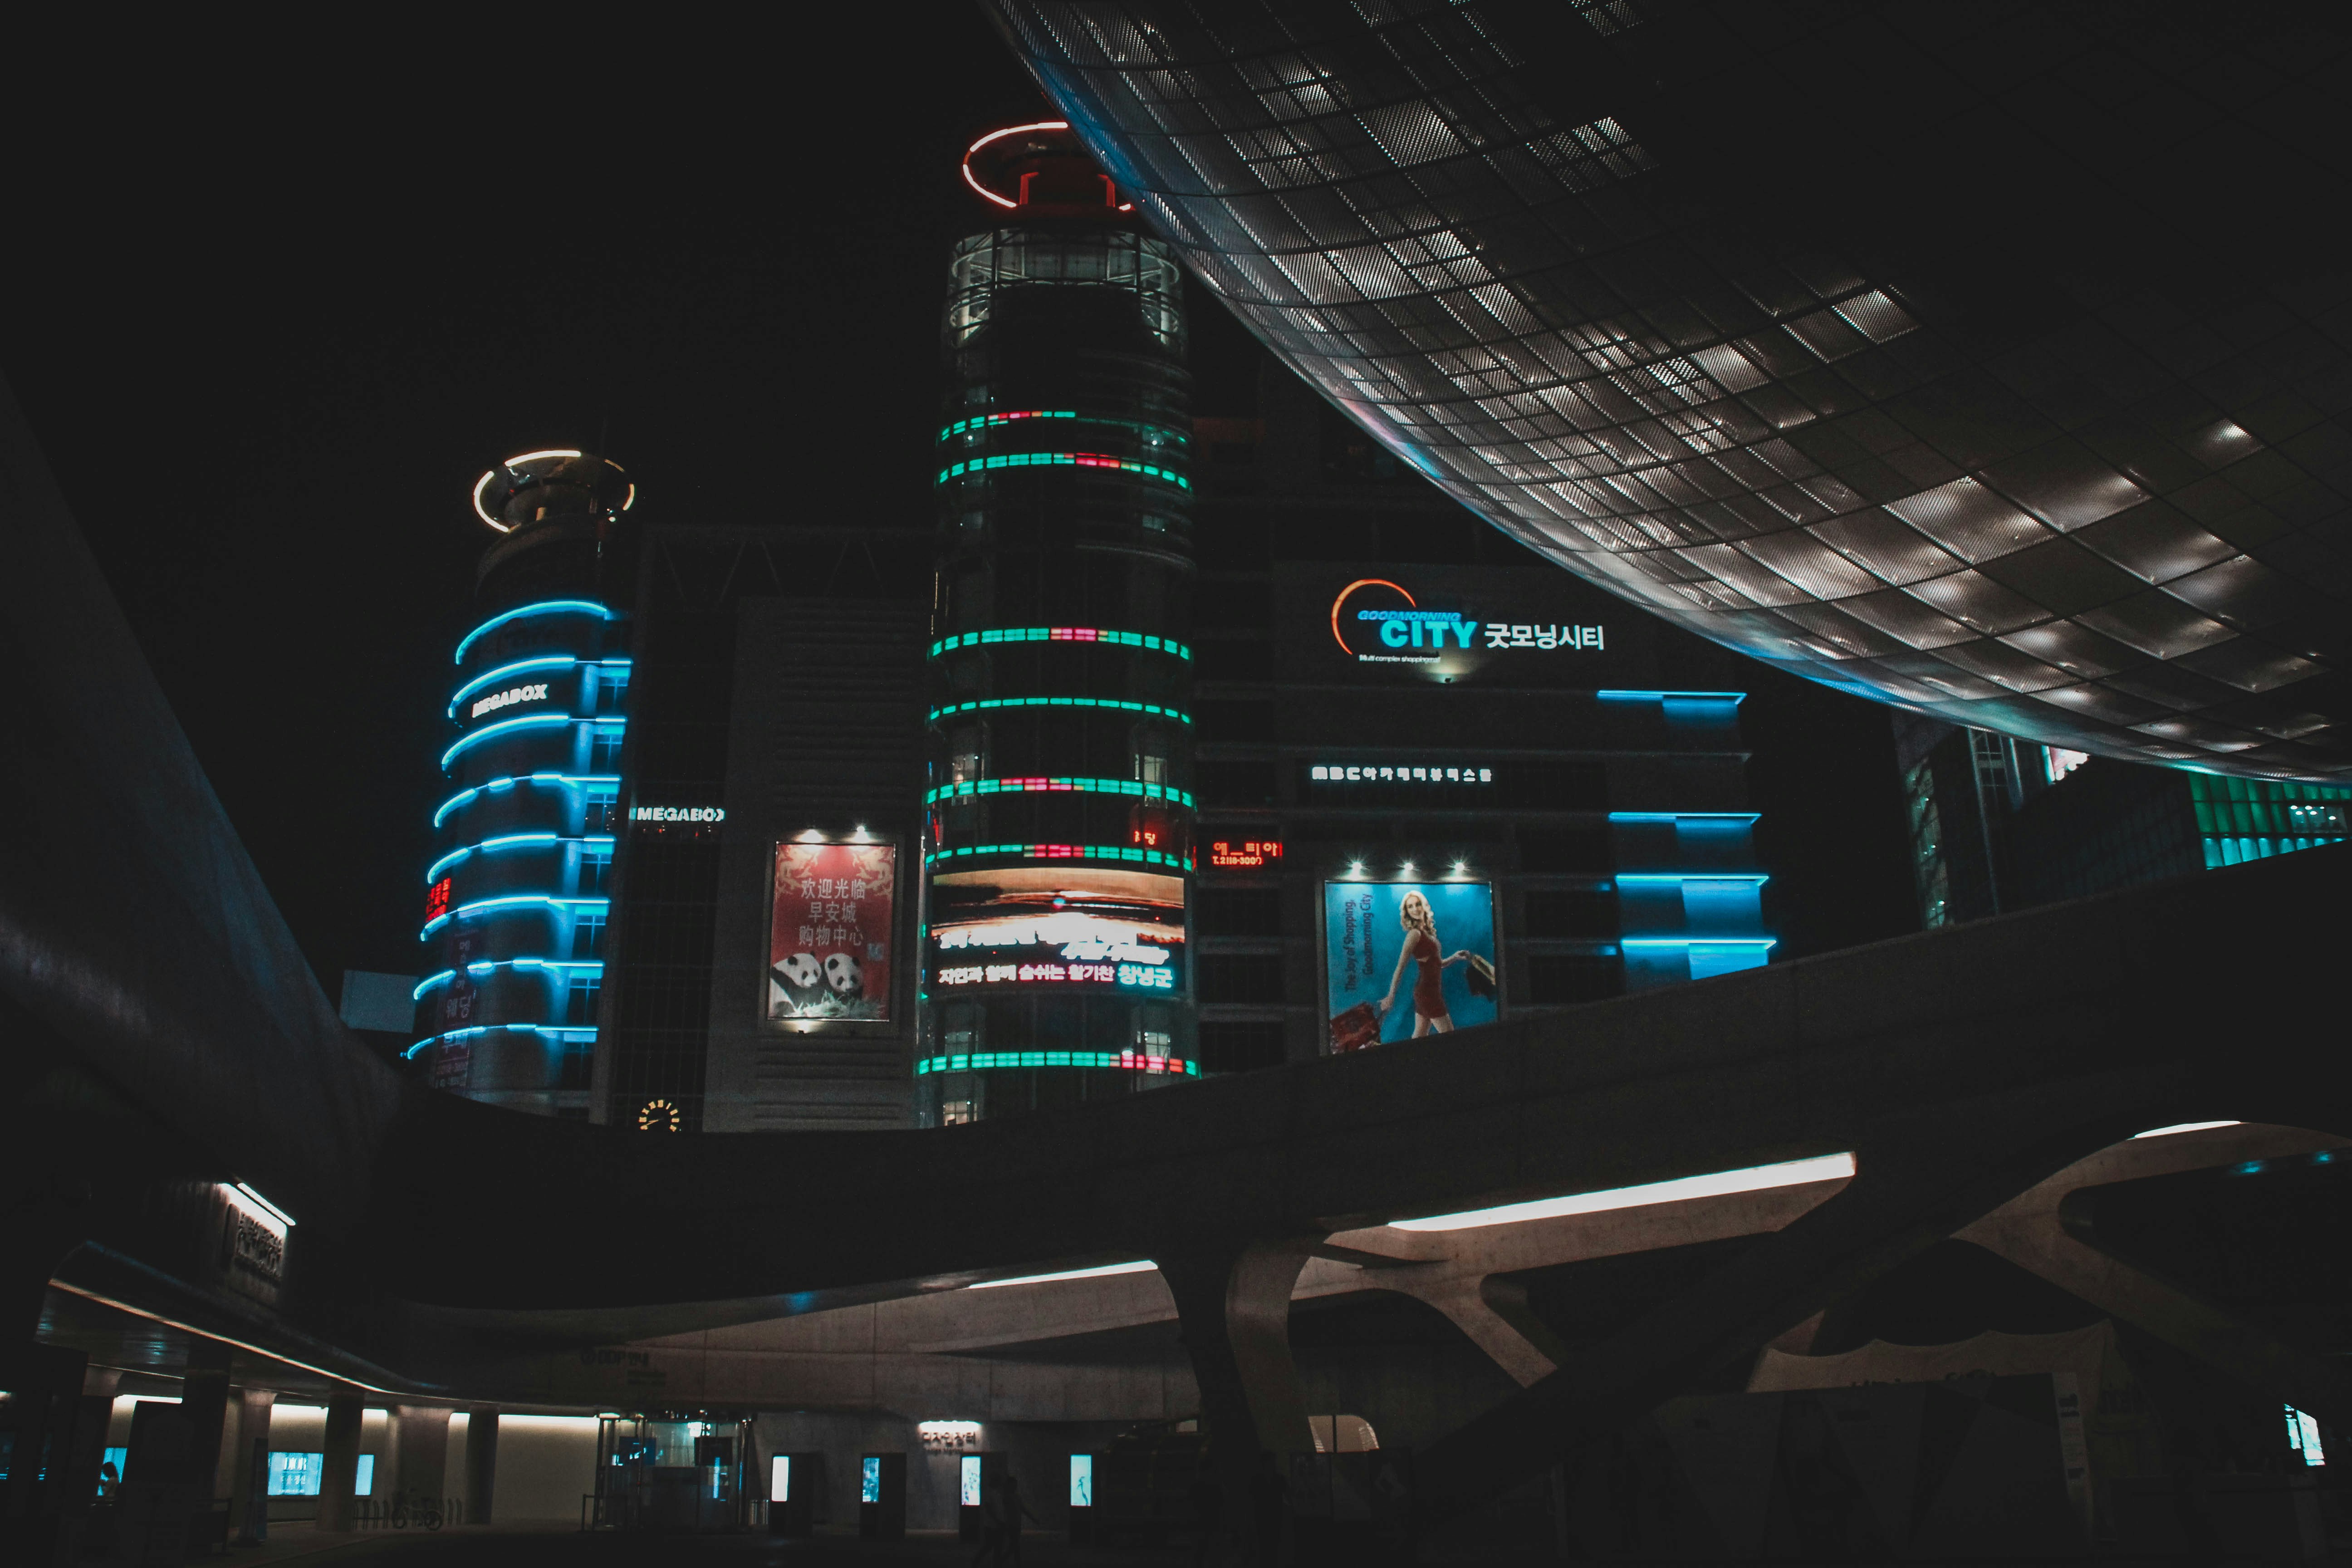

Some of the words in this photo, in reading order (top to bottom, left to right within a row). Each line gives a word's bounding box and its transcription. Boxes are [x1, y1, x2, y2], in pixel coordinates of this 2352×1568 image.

[1358, 610, 1461, 621] GOODMORNING
[1381, 620, 1478, 648] CITY
[1484, 623, 1604, 650] 굿모닝시티
[472, 683, 548, 718] MEGABOX
[801, 878, 866, 899] 欢迎光临
[808, 901, 857, 923] 早安城
[1360, 894, 1373, 911] City
[799, 925, 864, 947] 购物中心
[938, 966, 984, 985] 자연과
[1019, 964, 1065, 981] 숨쉬는
[1117, 964, 1173, 988] 창녕군
